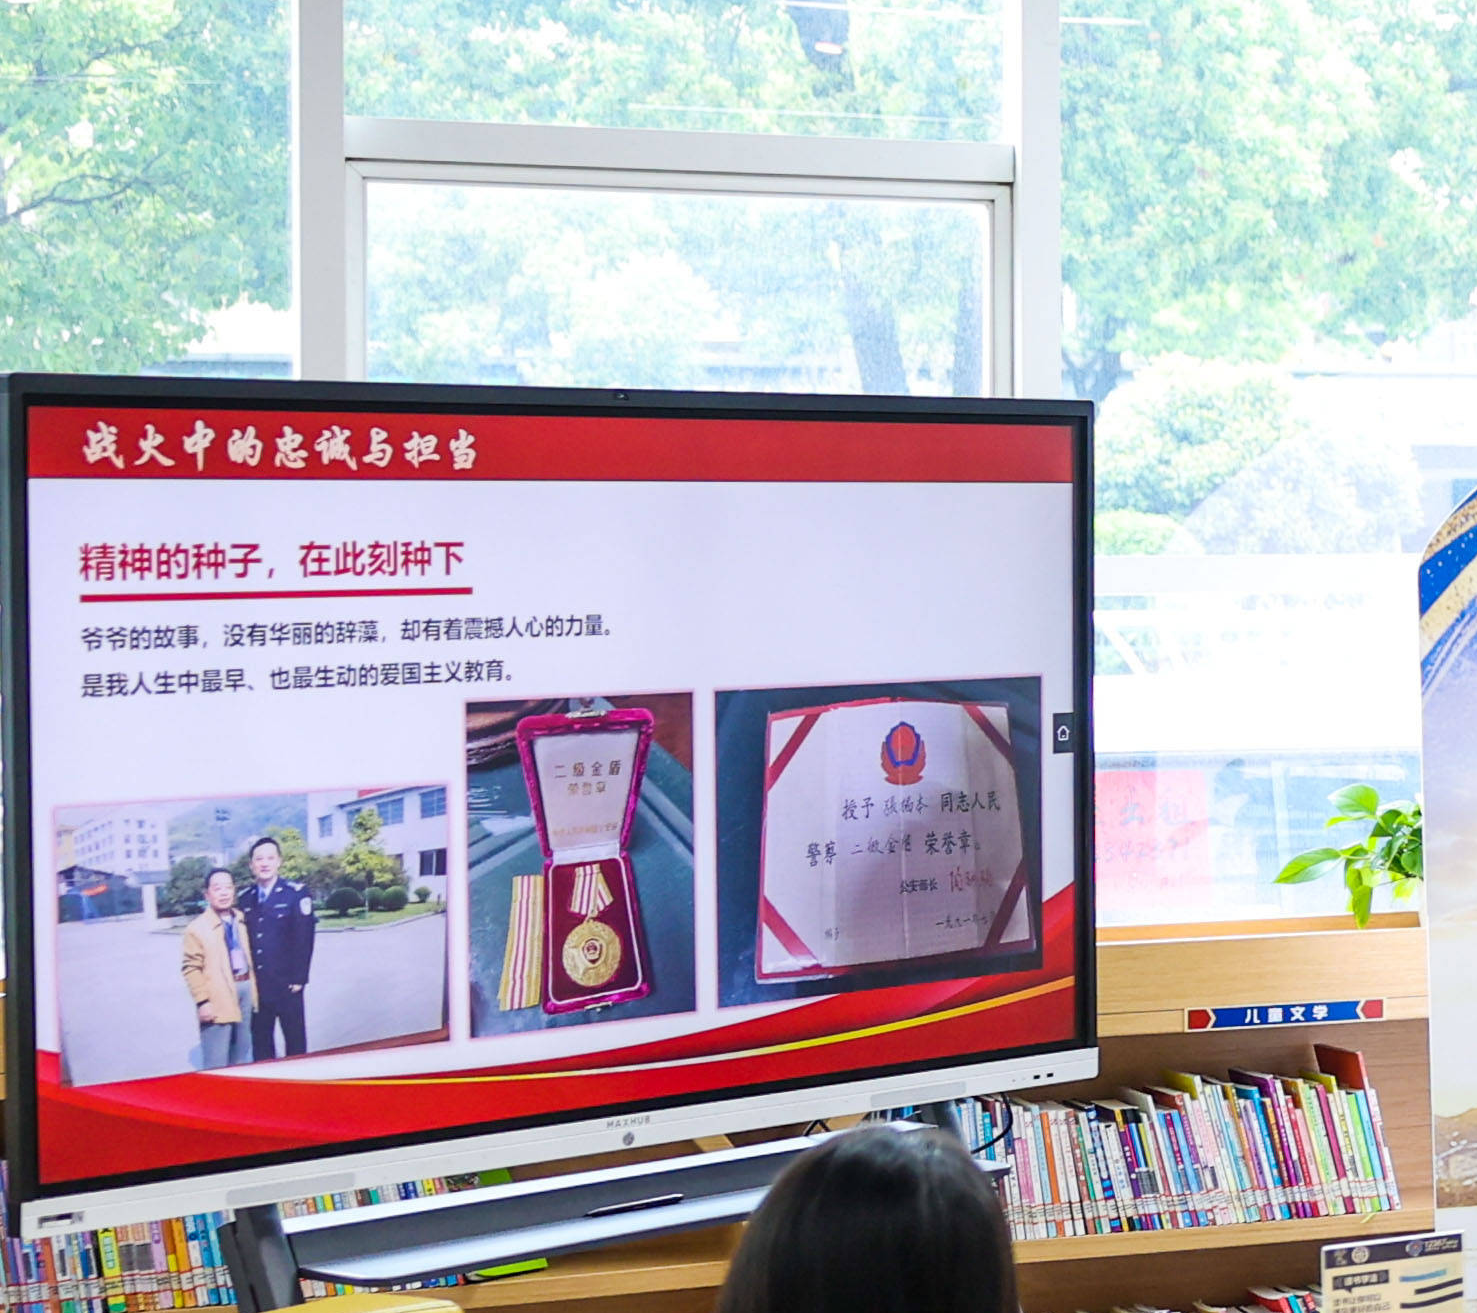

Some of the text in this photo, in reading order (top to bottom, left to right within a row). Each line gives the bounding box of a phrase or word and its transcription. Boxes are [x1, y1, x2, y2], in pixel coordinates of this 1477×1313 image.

[82, 419, 478, 472] 战火中的忠诚与担当
[79, 539, 465, 582] 精神的种子，在此刻种下
[1244, 1004, 1329, 1025] 儿童文学
[606, 1115, 651, 1128] MAXHUB
